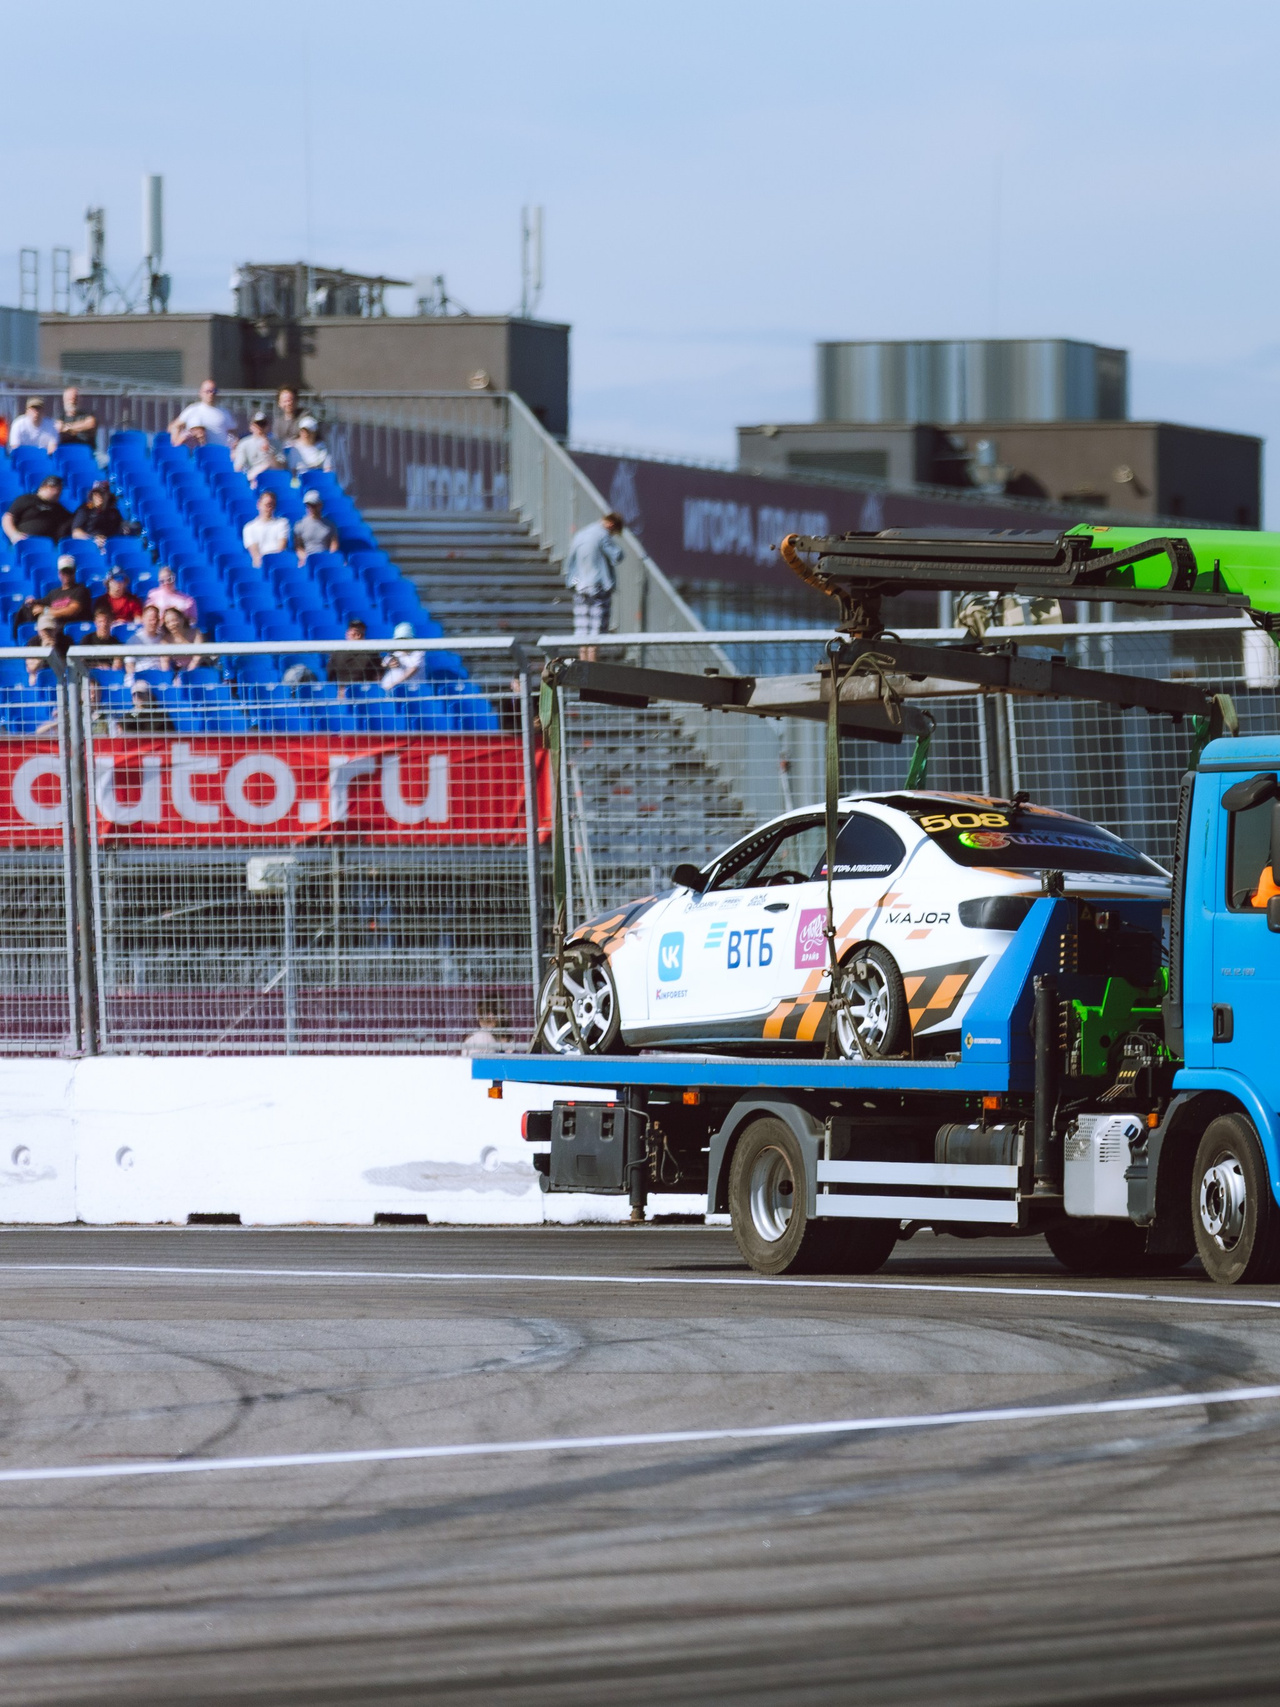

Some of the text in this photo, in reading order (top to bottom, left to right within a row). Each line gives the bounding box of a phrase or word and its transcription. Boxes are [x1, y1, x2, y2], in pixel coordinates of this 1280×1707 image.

[12, 742, 449, 825] auto.ru
[919, 812, 1009, 833] 508
[885, 912, 951, 924] MAJOR
[727, 927, 775, 969] ВТБ
